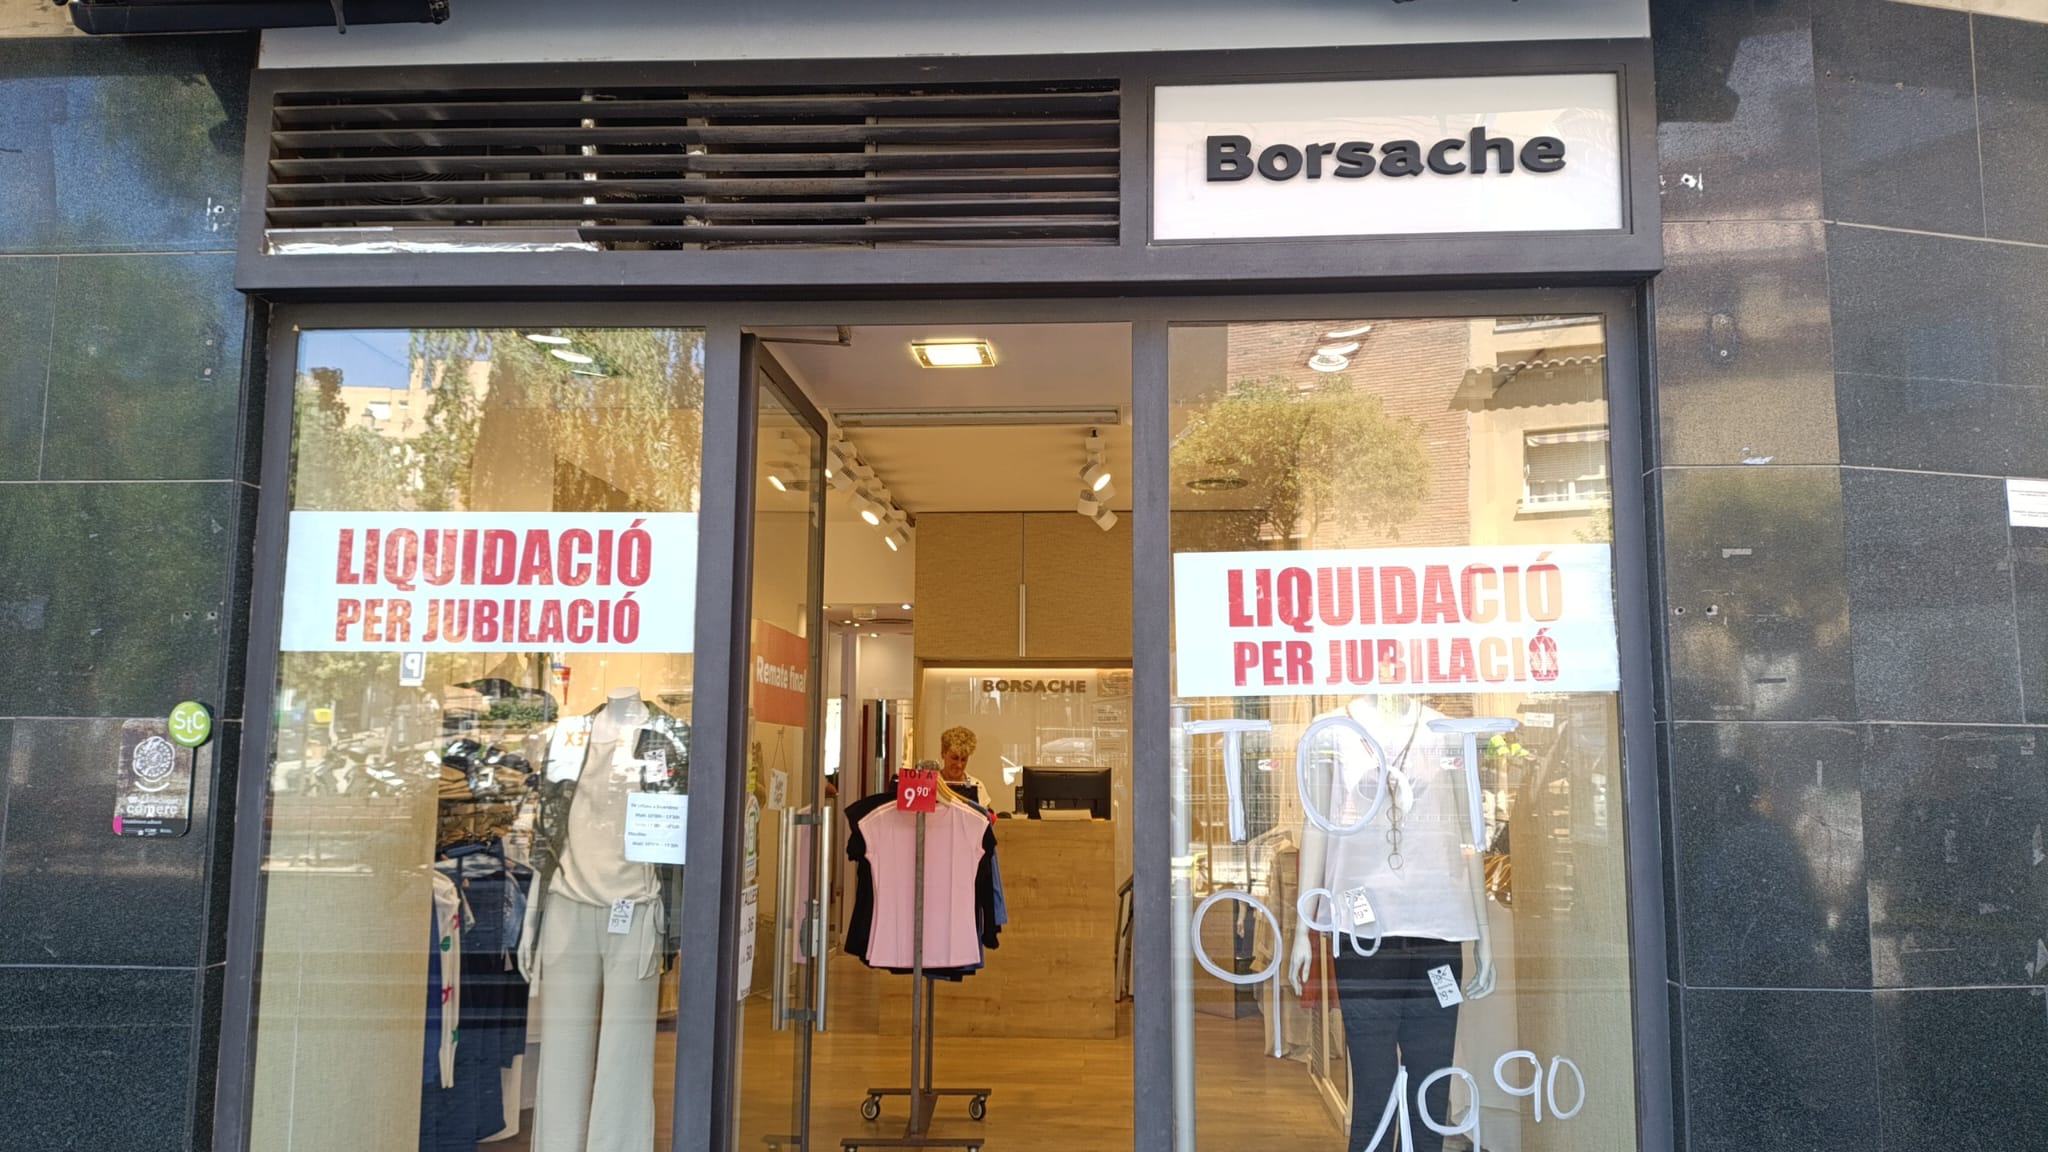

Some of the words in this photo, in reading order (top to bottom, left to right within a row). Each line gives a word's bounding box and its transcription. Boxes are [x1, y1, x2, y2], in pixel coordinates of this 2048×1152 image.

[1206, 126, 1566, 182] Borsache
[337, 519, 652, 590] LIQUIDACIÓ
[336, 598, 411, 643] PER
[422, 591, 641, 644] JUBILACIÓ
[1227, 551, 1562, 633] LIQUIDACIÓ
[756, 655, 789, 689] Remate
[789, 665, 807, 693] final
[1234, 641, 1314, 686] PER
[1326, 627, 1559, 685] JUBILACIÓ
[982, 679, 1087, 694] BORSACHE
[1183, 715, 1520, 852] TOT
